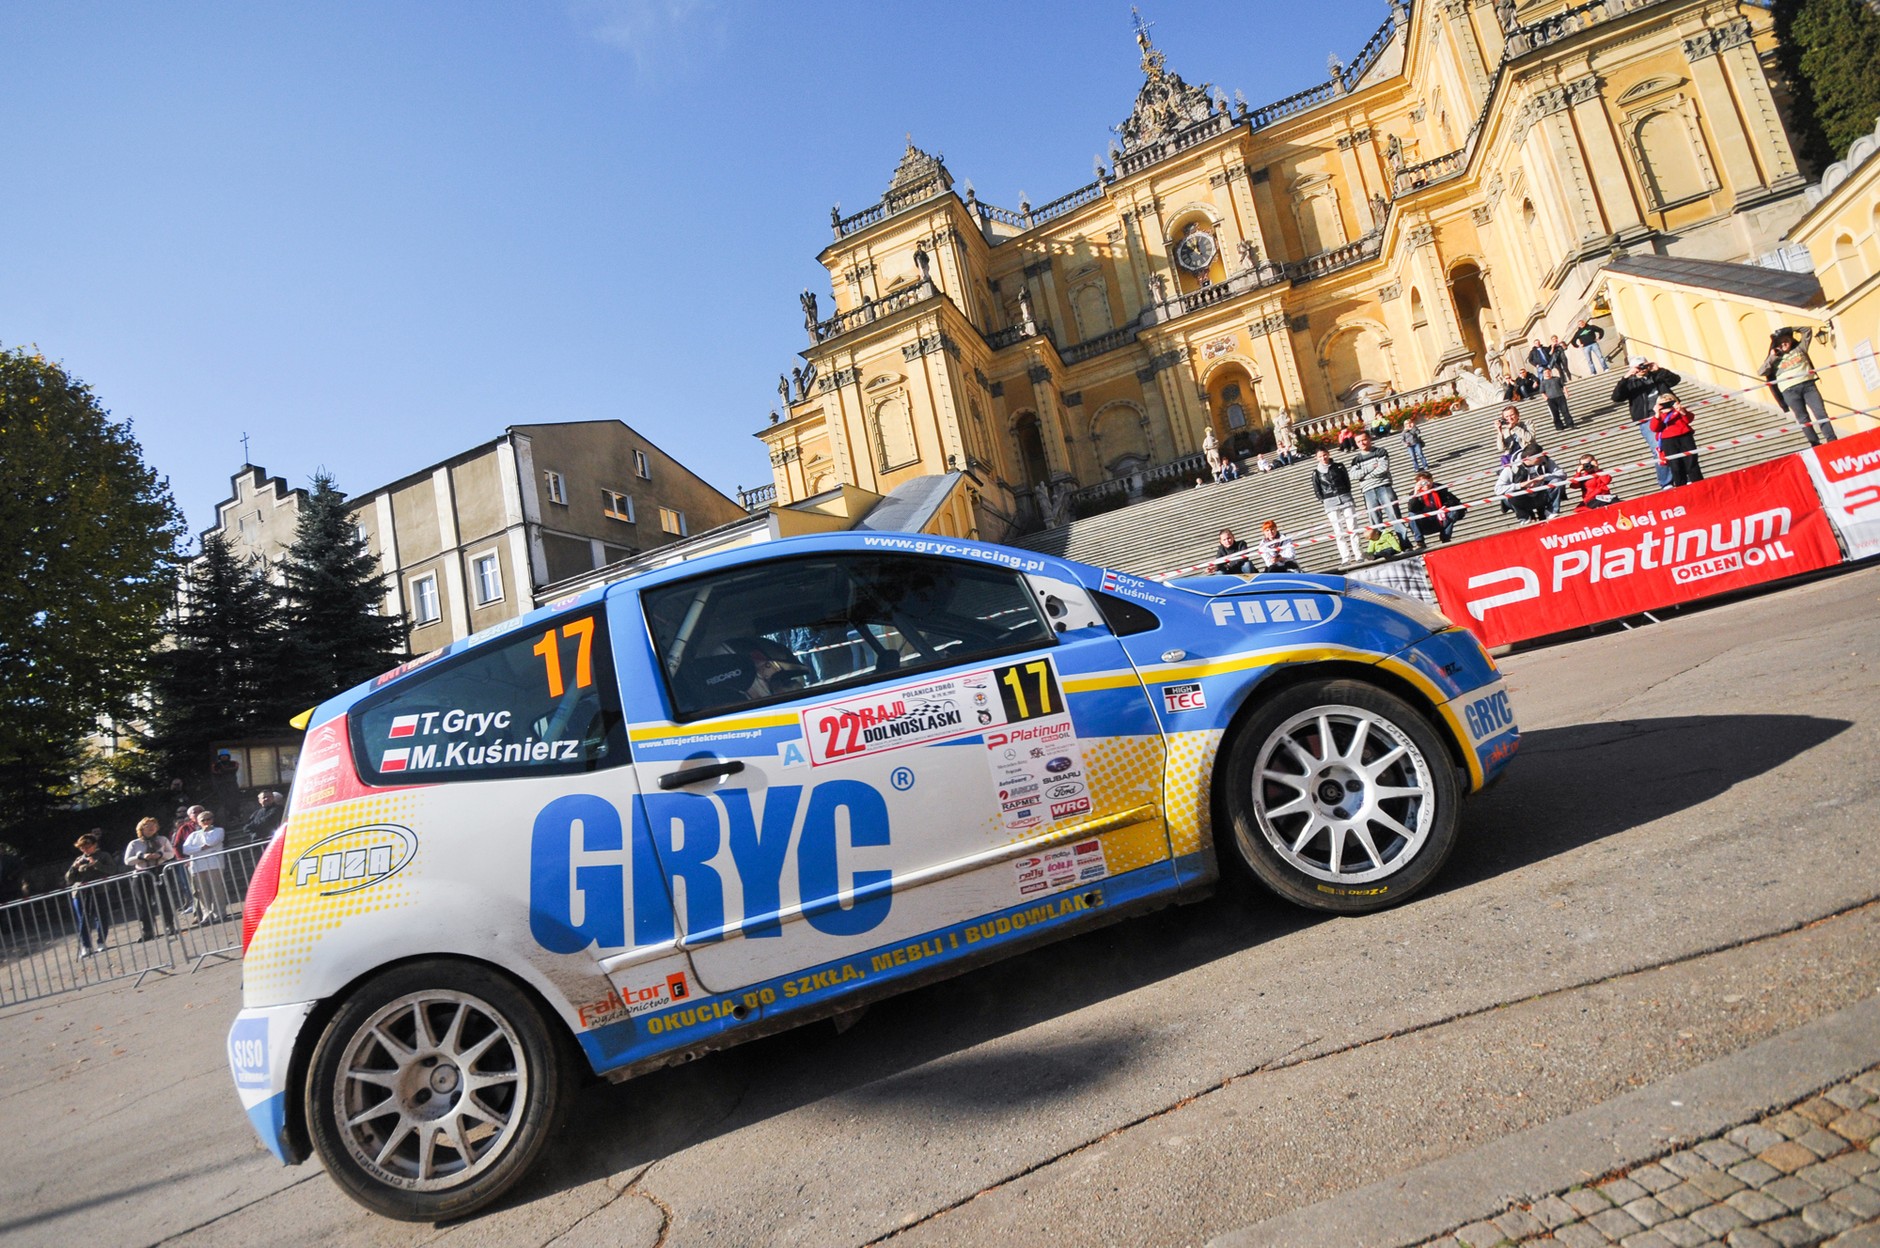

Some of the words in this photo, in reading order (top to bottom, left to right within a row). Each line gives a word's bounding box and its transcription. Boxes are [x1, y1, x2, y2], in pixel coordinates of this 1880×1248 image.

[1540, 524, 1616, 550] Wymień
[1661, 505, 1687, 521] na
[863, 537, 1045, 572] www.gryc-racing.pl
[1552, 506, 1792, 593] Platinum
[1676, 556, 1738, 580] ORLEN
[1743, 541, 1795, 568] OIL
[1115, 584, 1167, 606] Kuśnierz
[1117, 574, 1145, 588] Gryc
[1210, 598, 1323, 626] FAZA
[532, 616, 595, 698] 17
[706, 669, 742, 686] RECARO
[1003, 661, 1051, 718] 17
[1172, 686, 1193, 694] HIGH
[1165, 692, 1205, 710] TEC
[1464, 690, 1513, 740] GRYC
[421, 709, 512, 736] T.Gryc
[819, 712, 866, 759] 22
[859, 700, 905, 729] RAJD
[863, 709, 963, 743] DOLNOŚLĄSKI
[1011, 722, 1070, 743] Platinum
[410, 737, 579, 770] M.Kuśnierz
[638, 729, 762, 749] www.WizjerElektroniczny.pl
[783, 743, 805, 766] A
[1042, 771, 1081, 784] SUBARU
[1053, 785, 1077, 798] Ford
[1002, 796, 1040, 810] RAPMET
[1052, 799, 1088, 815] WRC
[296, 845, 392, 886] FAZA
[530, 779, 893, 954] GRYC
[647, 998, 736, 1035] OKUCIA
[783, 964, 866, 998] SZKŁA,
[871, 937, 943, 972] MEBLI
[948, 932, 959, 948] I
[578, 983, 666, 1028] Faktor
[235, 1039, 263, 1068] SISO
